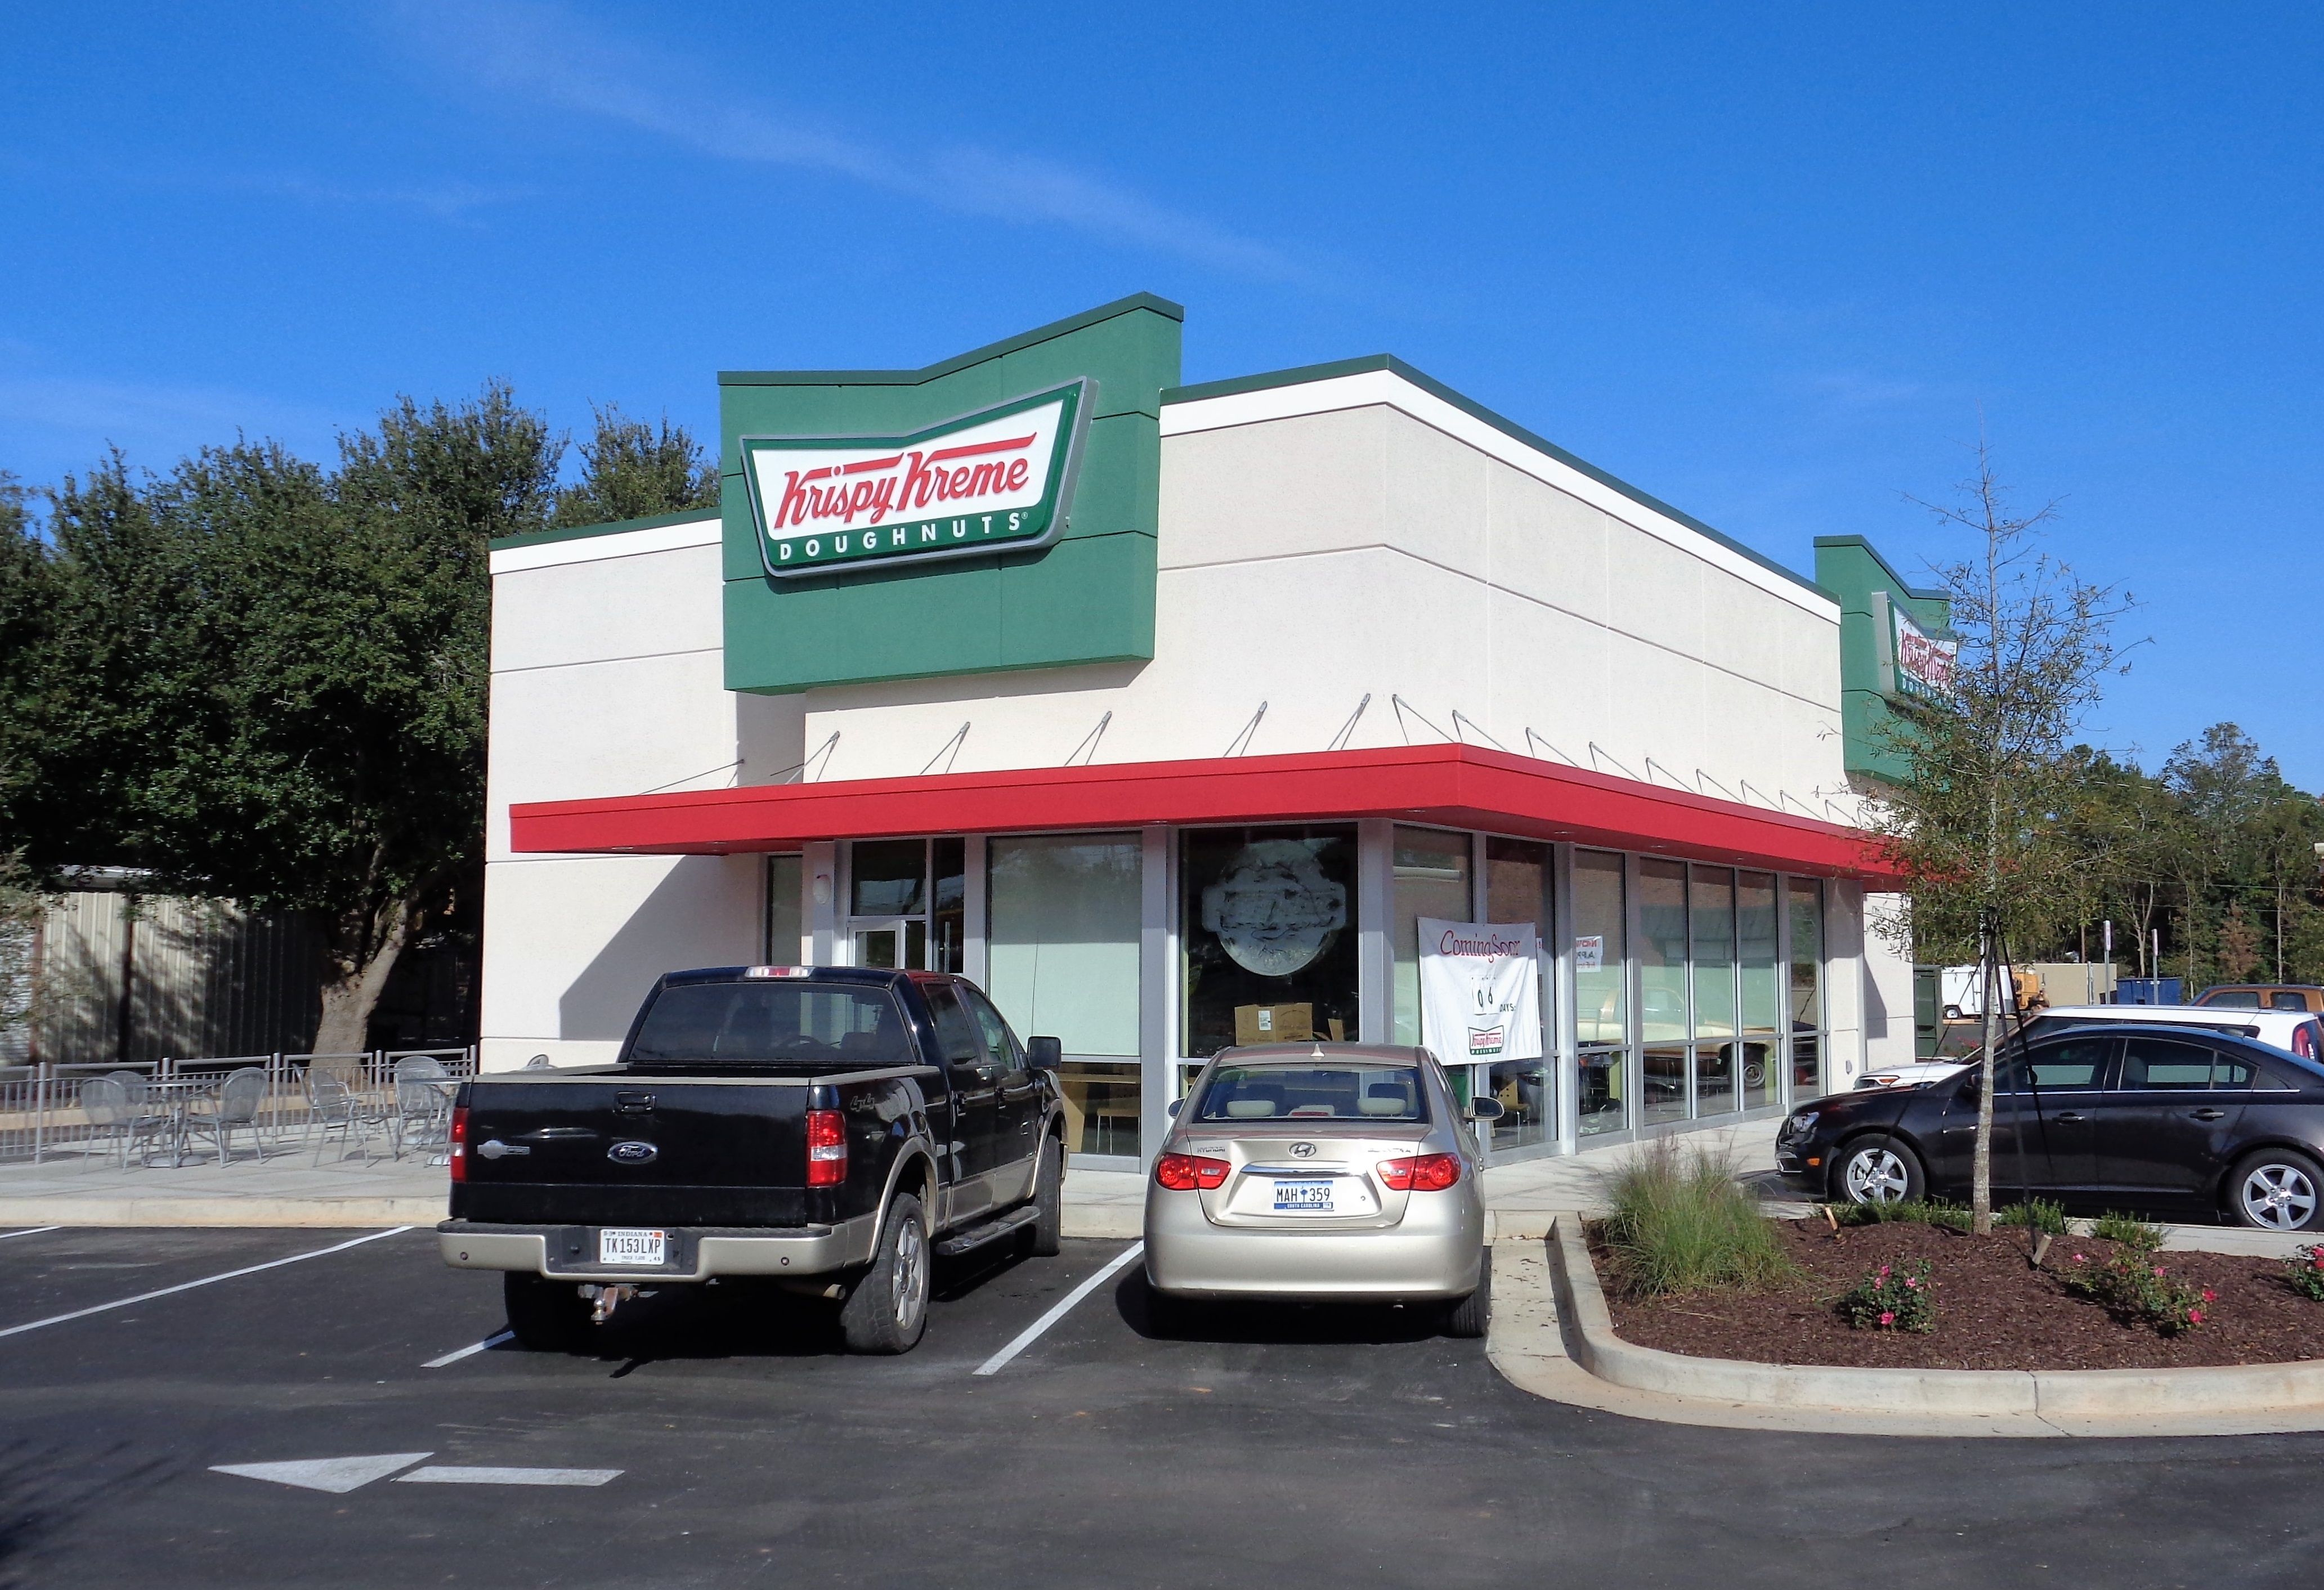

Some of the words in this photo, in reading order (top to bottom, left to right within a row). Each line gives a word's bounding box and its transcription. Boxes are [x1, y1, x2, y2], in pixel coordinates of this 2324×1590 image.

[773, 452, 904, 529] Krispy
[896, 431, 1037, 512] Kreme
[780, 512, 1020, 560] DOUGHNUTS
[1440, 930, 1494, 963] Coming
[619, 1145, 646, 1158] Ford
[1277, 1188, 1298, 1202] MAH
[1309, 1188, 1330, 1202] 359
